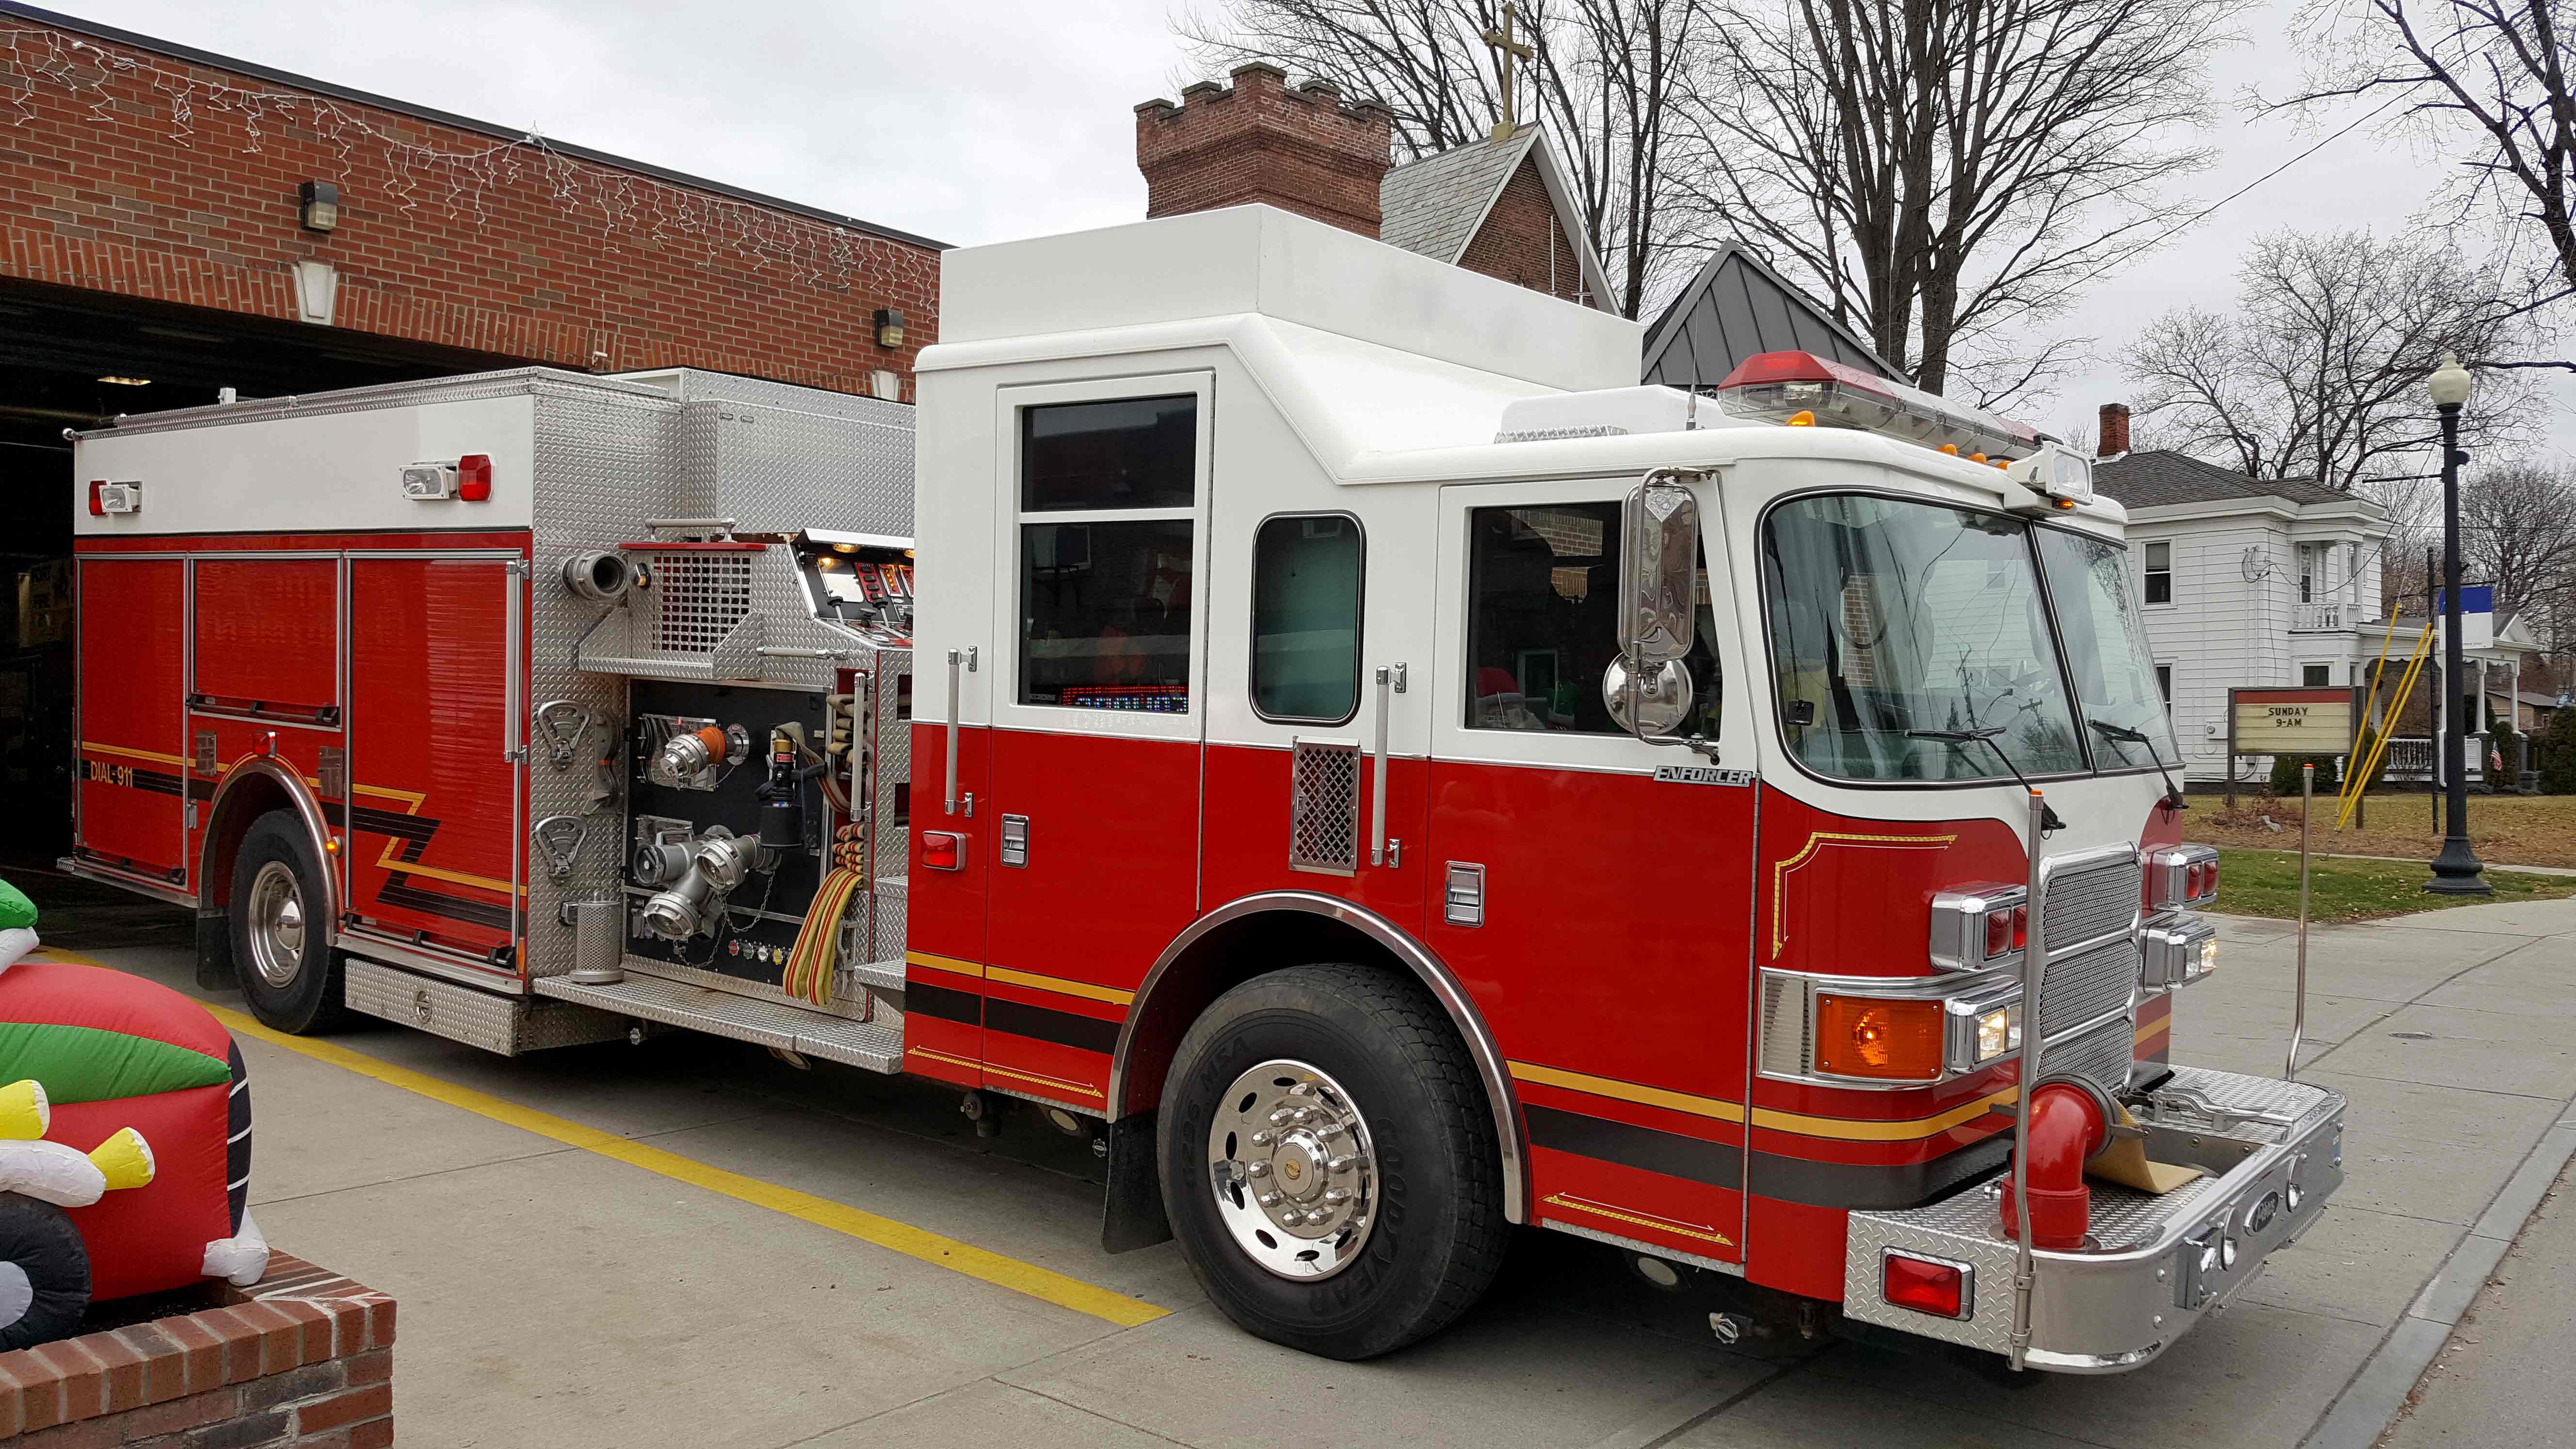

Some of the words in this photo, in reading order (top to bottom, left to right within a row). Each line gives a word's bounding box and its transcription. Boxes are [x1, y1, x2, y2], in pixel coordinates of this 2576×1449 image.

[2269, 707, 2308, 716] SUNDAY
[2276, 718, 2302, 727] 9-AM
[91, 760, 133, 788] DIAL-911
[1655, 766, 1754, 786] ENFORCER
